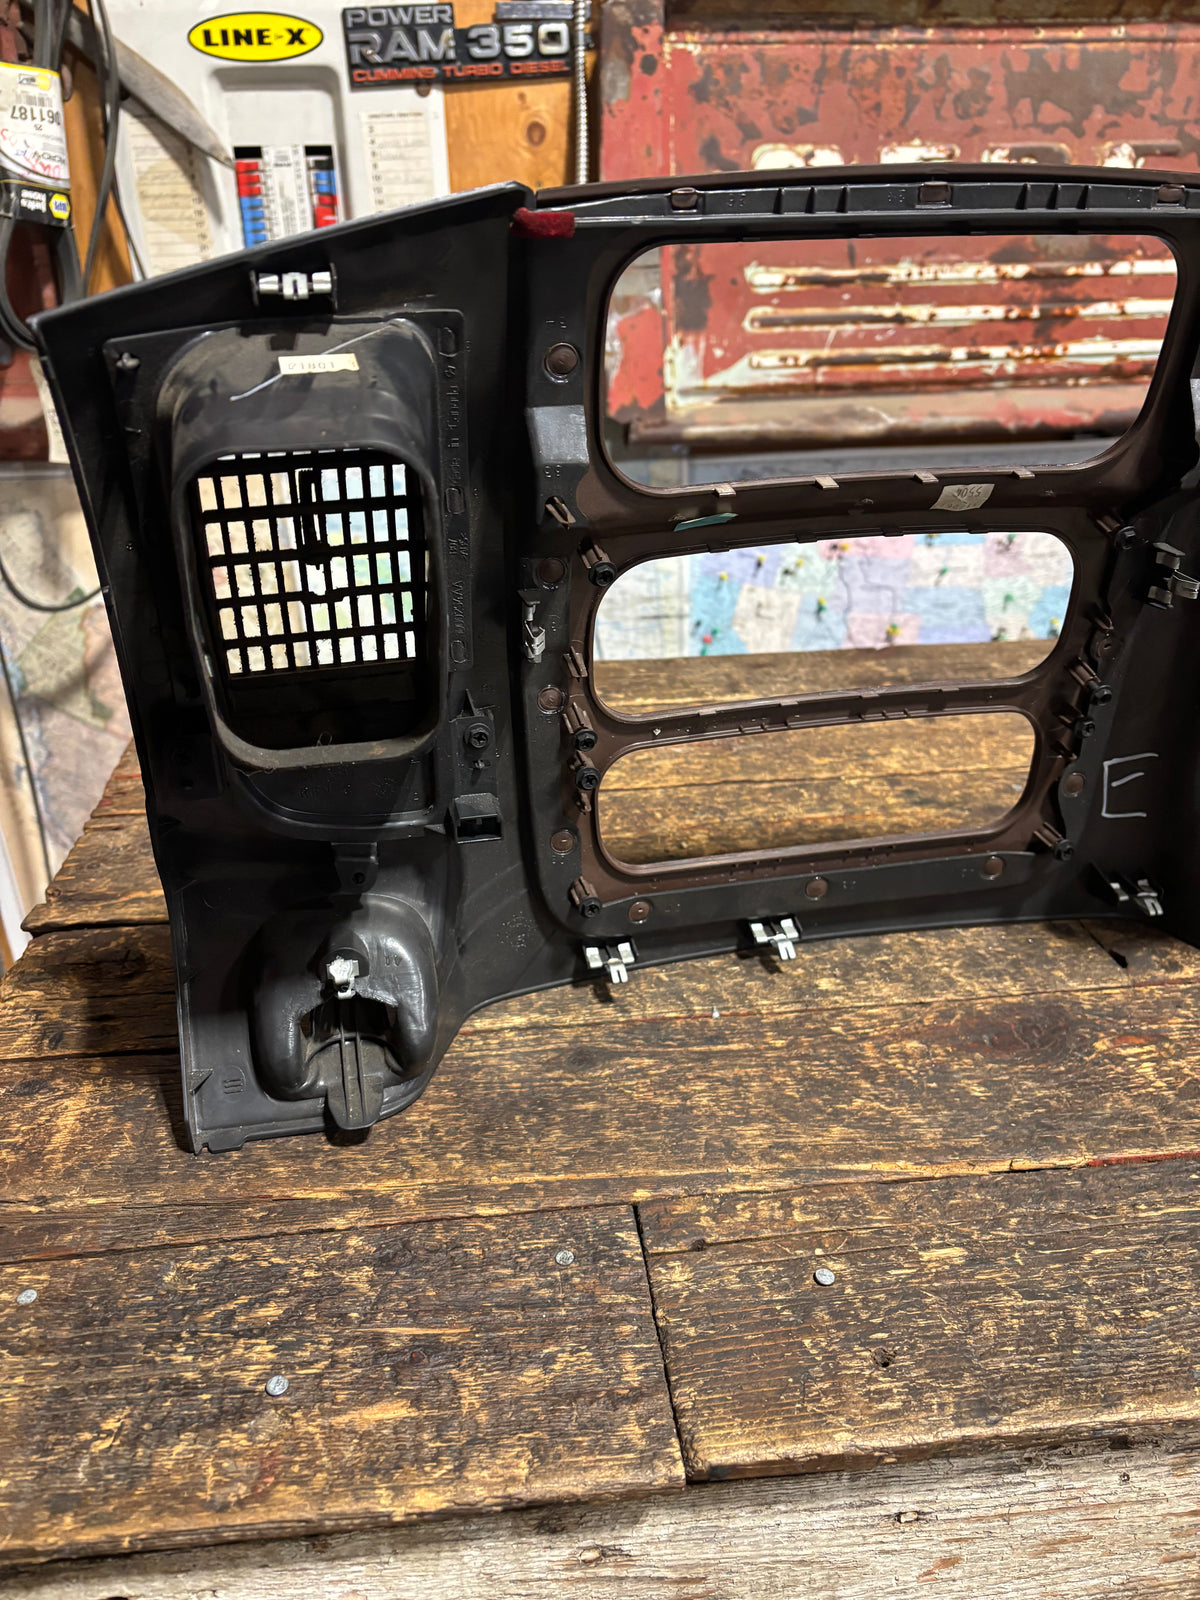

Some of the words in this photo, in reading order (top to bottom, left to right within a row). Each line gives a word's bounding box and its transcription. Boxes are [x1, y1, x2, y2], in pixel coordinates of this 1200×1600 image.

[345, 5, 453, 27] POWER
[203, 28, 307, 46] LINE-X
[346, 28, 456, 66] RAM
[467, 22, 570, 59] 350
[353, 67, 436, 82] CUMMINS
[442, 63, 503, 77] TURBO
[510, 60, 570, 74] DIESEL
[1101, 752, 1159, 818] E
